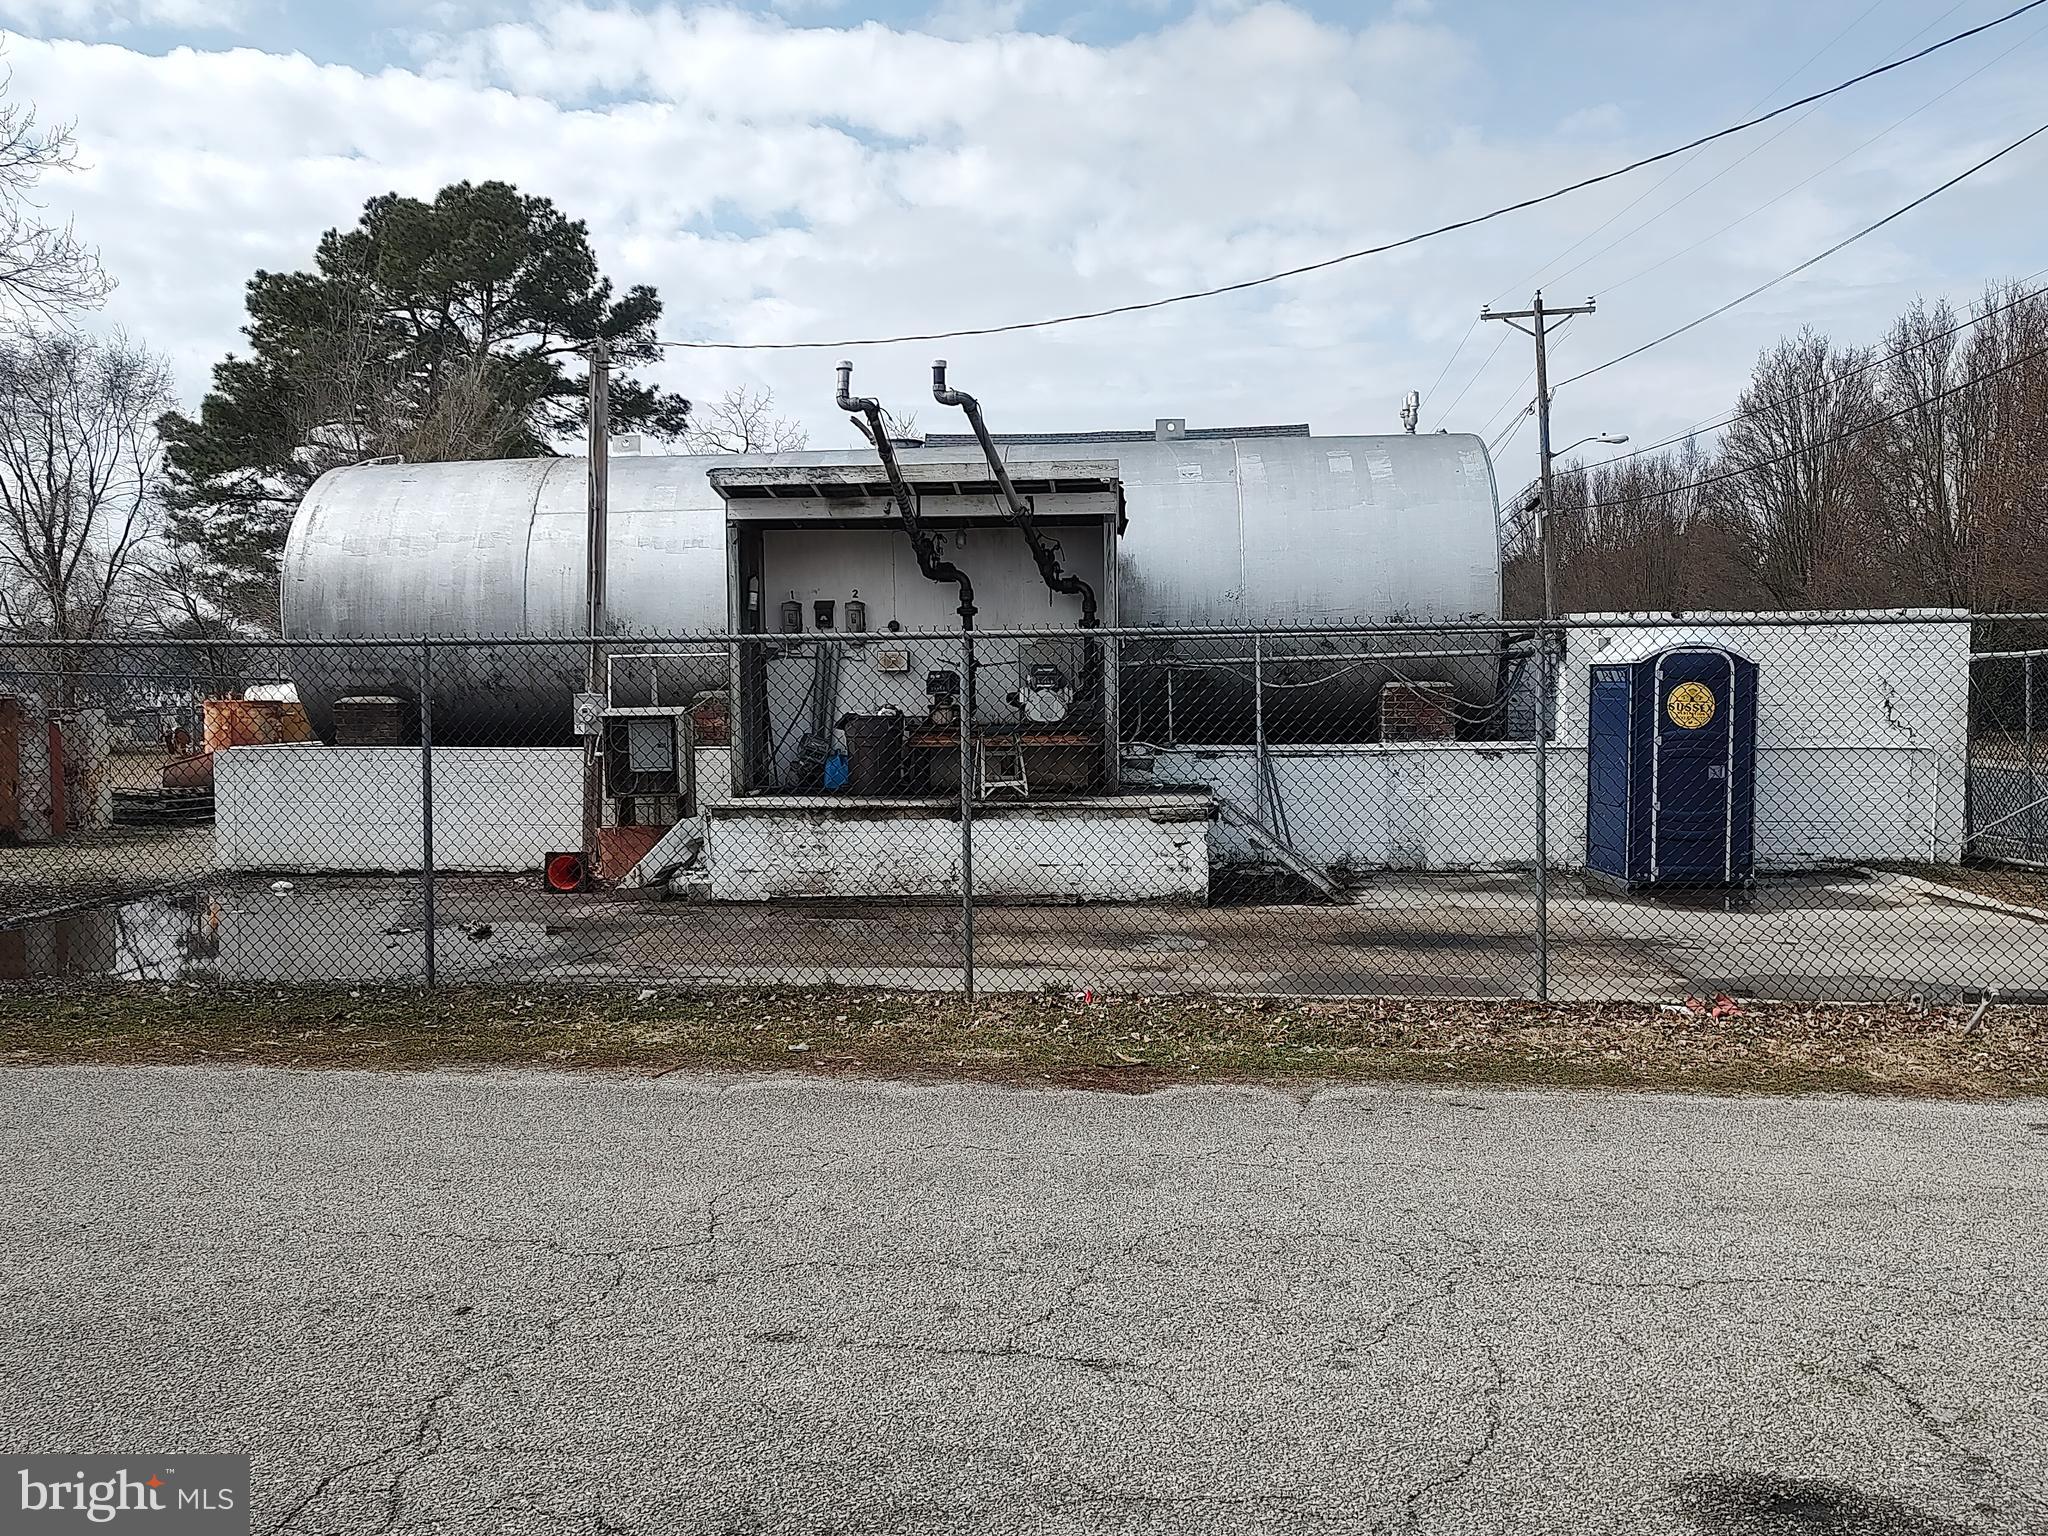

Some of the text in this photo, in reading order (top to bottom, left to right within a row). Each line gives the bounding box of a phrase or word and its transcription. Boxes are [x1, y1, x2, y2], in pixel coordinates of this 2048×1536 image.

[789, 590, 795, 600] 1
[852, 589, 859, 599] 2
[1669, 702, 1713, 712] SUSSEX
